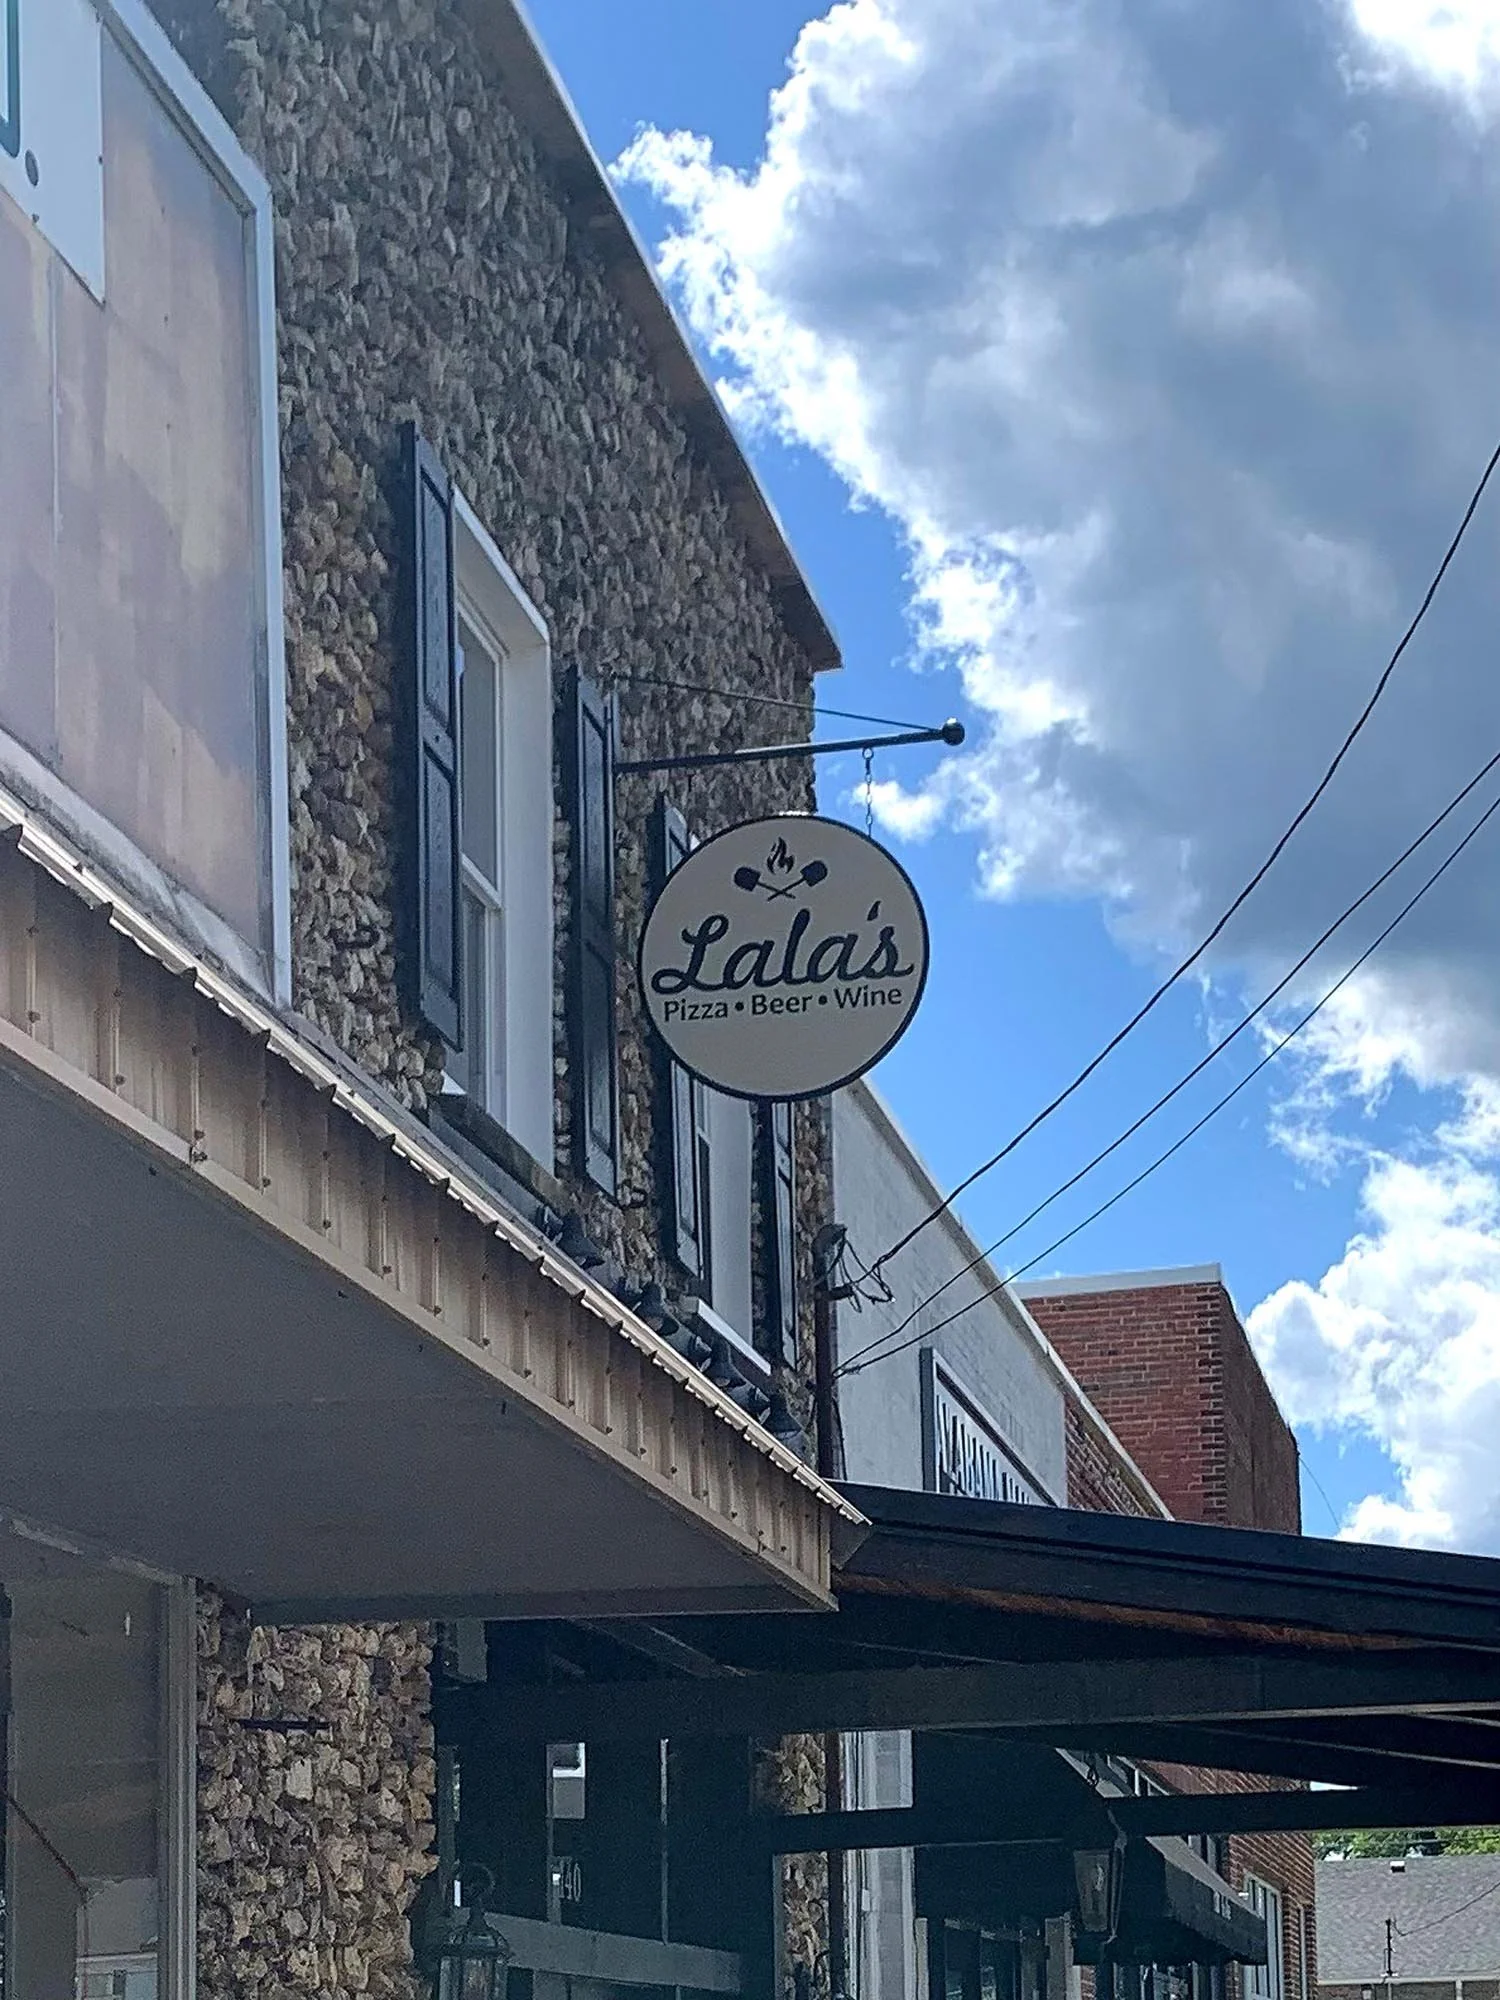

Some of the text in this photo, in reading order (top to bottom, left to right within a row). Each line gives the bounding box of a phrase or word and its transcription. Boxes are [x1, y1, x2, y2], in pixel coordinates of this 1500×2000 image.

[651, 900, 915, 995] Lala's
[663, 984, 902, 1022] Pizza Beer Wine
